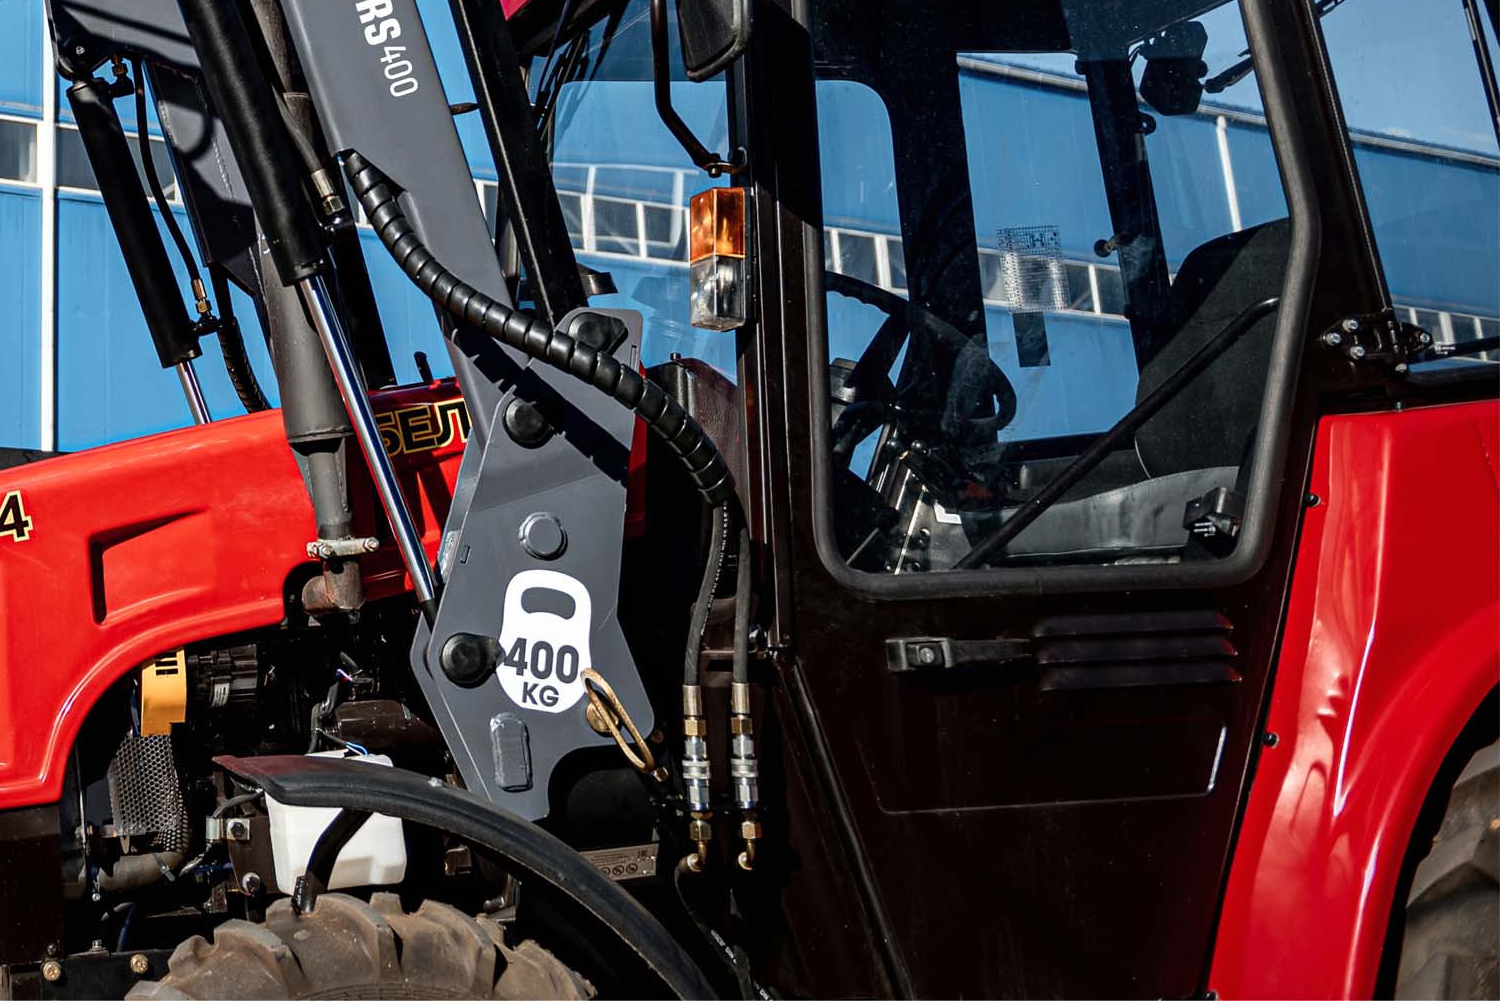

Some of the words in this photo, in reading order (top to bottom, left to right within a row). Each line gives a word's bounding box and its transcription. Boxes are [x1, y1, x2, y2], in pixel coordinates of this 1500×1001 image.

[380, 46, 419, 97] 400
[504, 637, 580, 684] 400
[521, 681, 560, 708] KG
